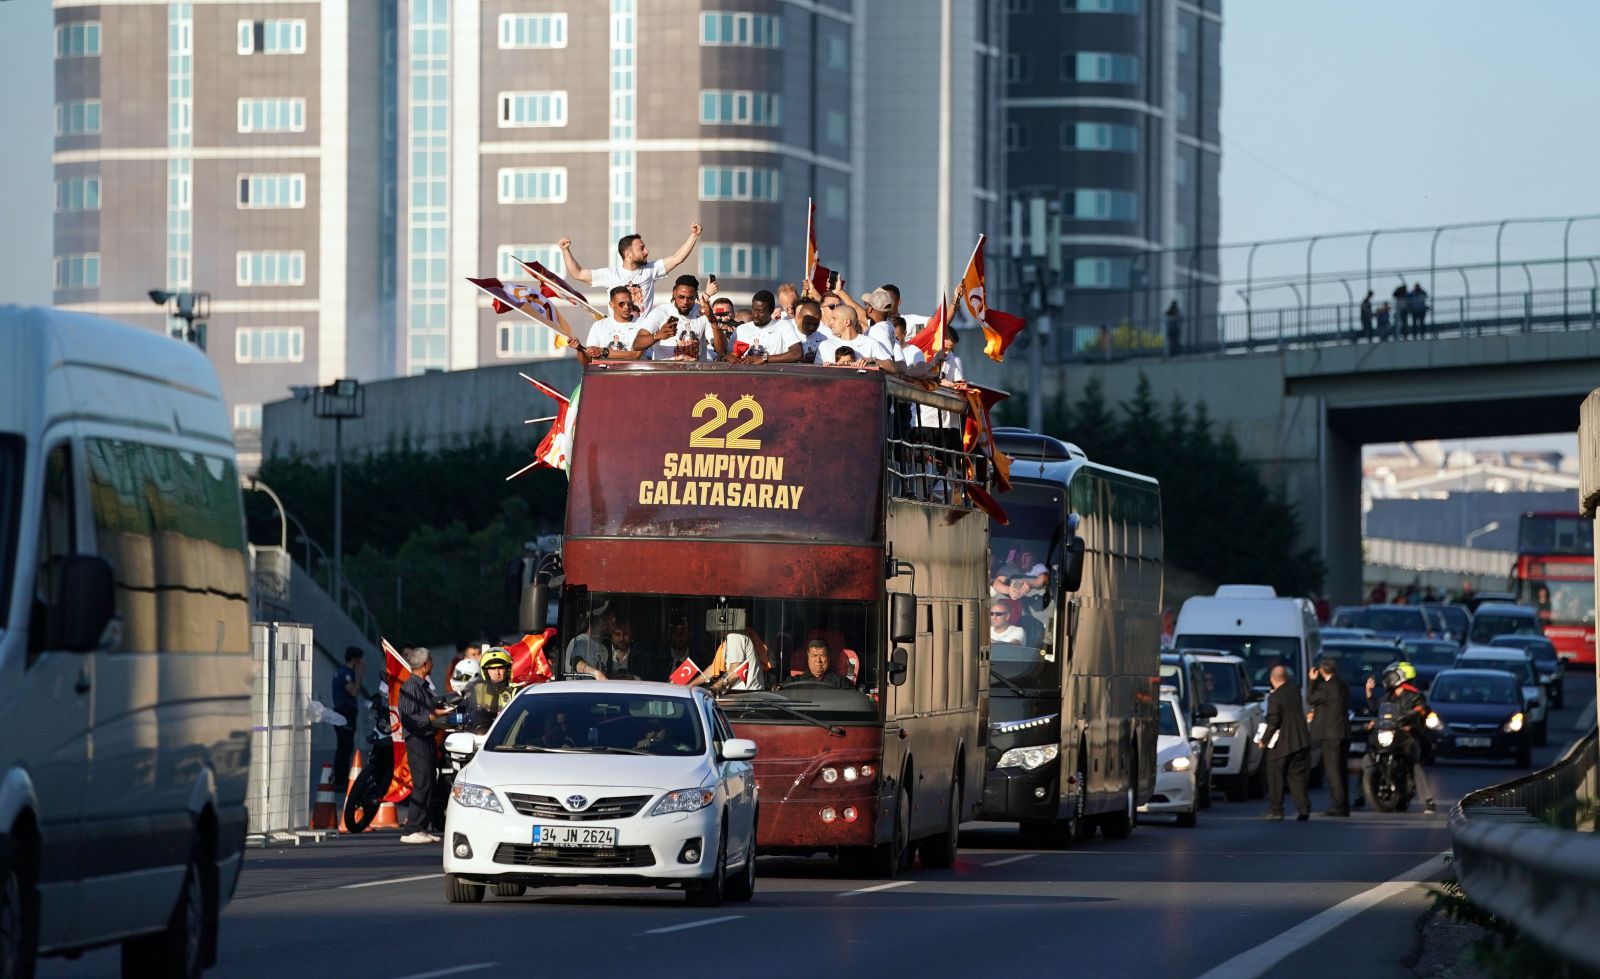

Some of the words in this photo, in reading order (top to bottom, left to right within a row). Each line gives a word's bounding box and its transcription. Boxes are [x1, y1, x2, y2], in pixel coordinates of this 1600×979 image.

[689, 393, 764, 450] 22
[663, 453, 784, 480] ŞAMPİYON
[638, 480, 804, 510] GALATASARAY
[542, 828, 557, 841] 34
[562, 829, 578, 842] JN
[583, 829, 613, 843] 2624
